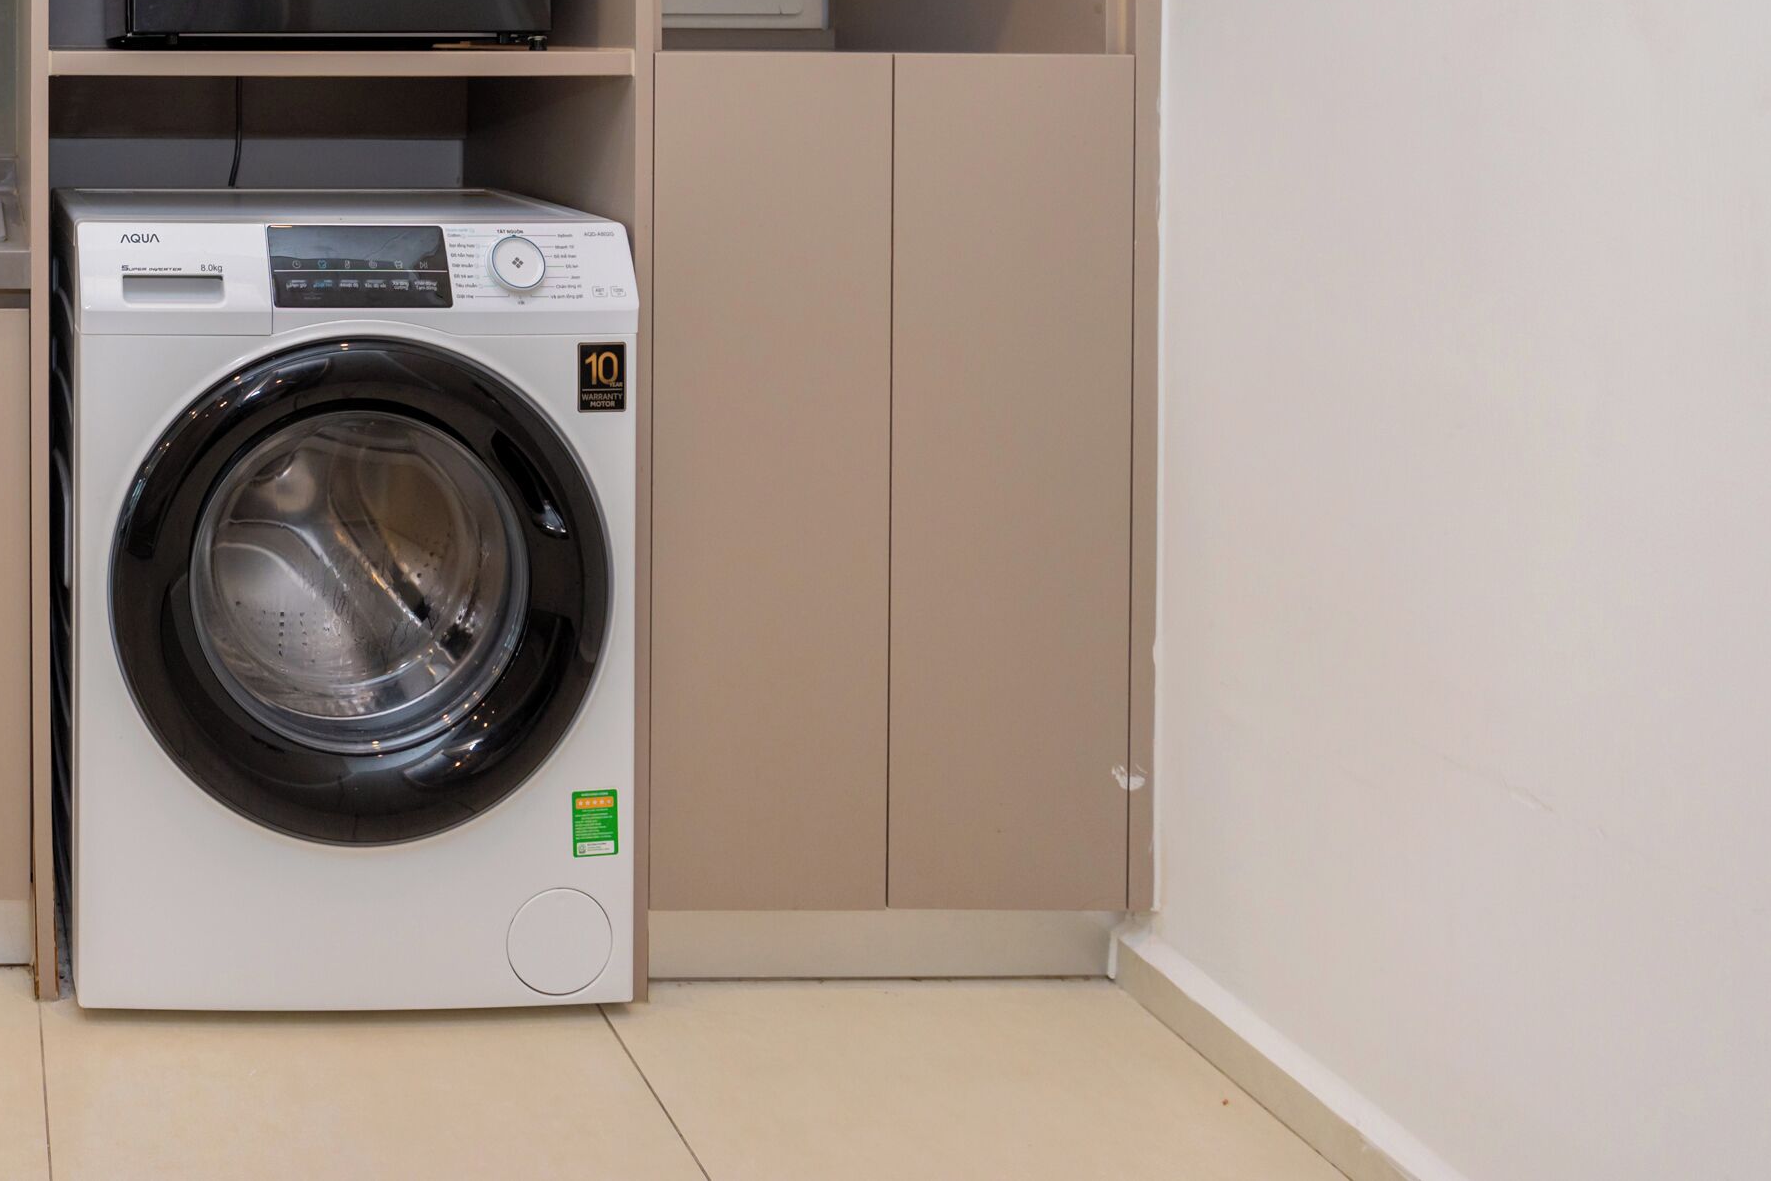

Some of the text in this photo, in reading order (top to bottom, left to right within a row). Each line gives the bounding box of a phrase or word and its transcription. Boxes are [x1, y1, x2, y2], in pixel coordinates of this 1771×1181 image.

[120, 233, 160, 243] AQUA
[201, 264, 223, 273] 8.0kg
[585, 351, 619, 385] 10
[582, 393, 623, 401] WARRANTY
